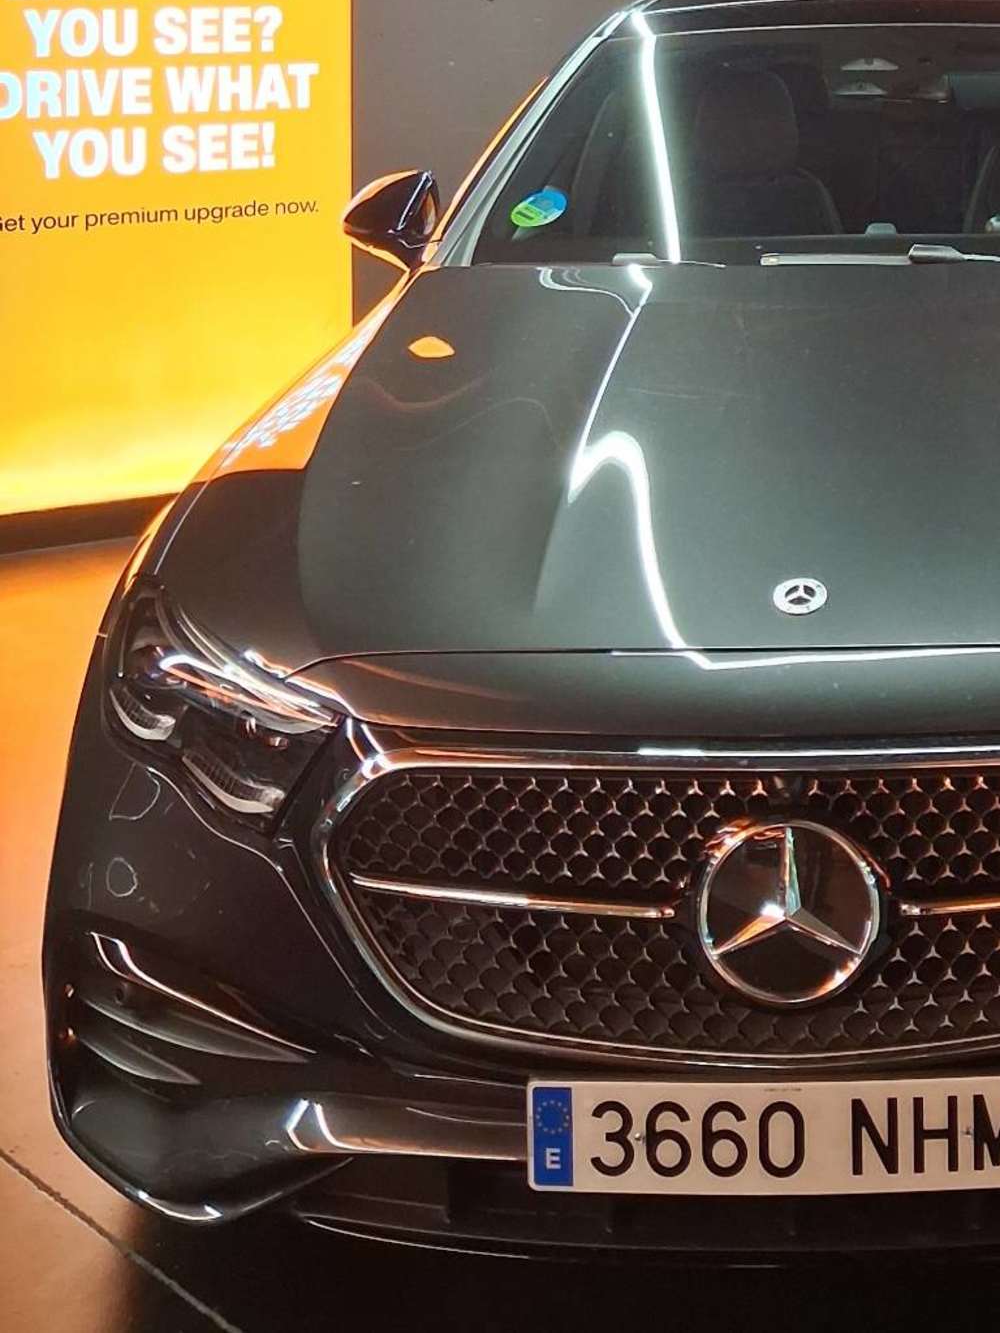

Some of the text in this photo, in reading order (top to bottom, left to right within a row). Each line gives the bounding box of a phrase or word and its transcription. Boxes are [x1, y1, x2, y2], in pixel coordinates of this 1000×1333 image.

[23, 5, 284, 58] YOU SEE?
[164, 63, 320, 114] WHAT
[32, 122, 276, 181] YOU SEE!
[31, 215, 78, 235] your
[85, 207, 178, 231] premium
[184, 200, 269, 226] upgrade
[275, 199, 319, 215] now.
[545, 1147, 561, 1169] E
[590, 1100, 806, 1178] 3660
